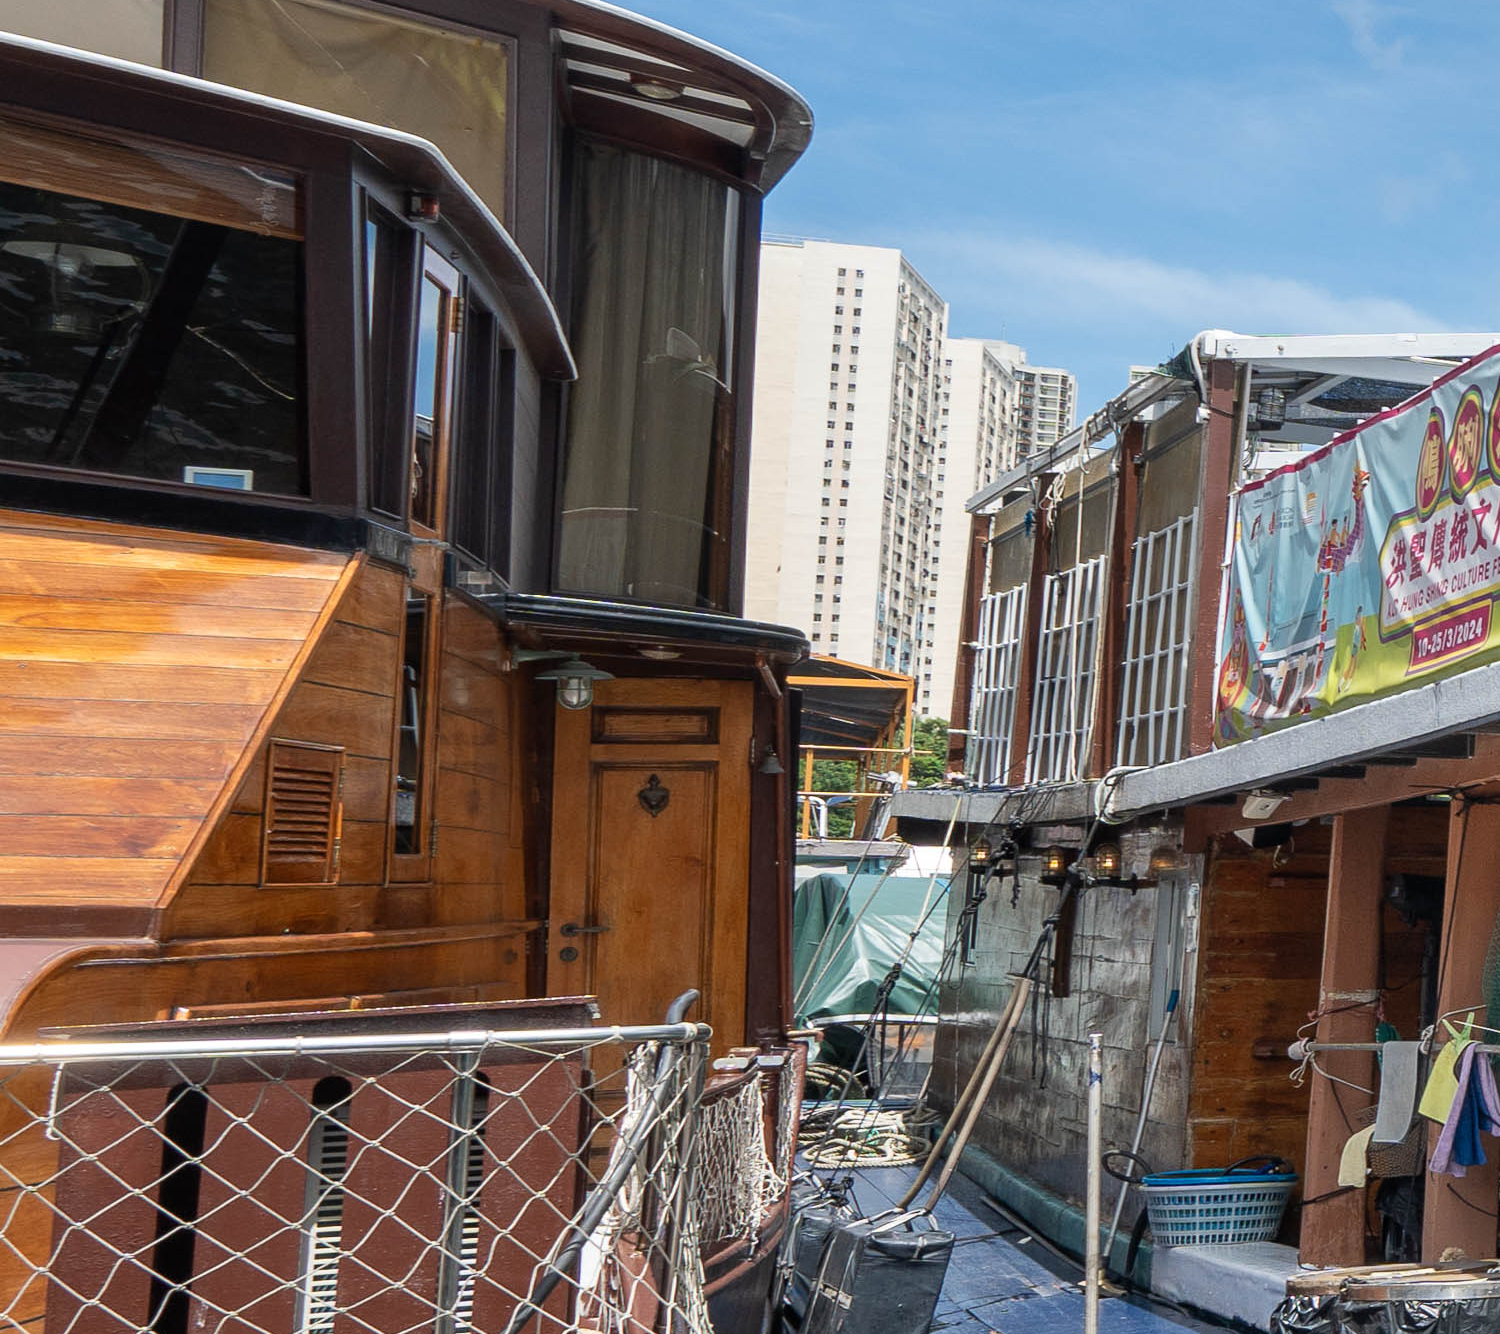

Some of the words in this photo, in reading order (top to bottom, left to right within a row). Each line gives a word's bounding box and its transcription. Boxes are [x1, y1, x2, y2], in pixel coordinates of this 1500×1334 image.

[1400, 590, 1424, 613] HUNG
[1450, 566, 1490, 593] CULTURE
[1416, 617, 1484, 659] 10-25/3/2024
